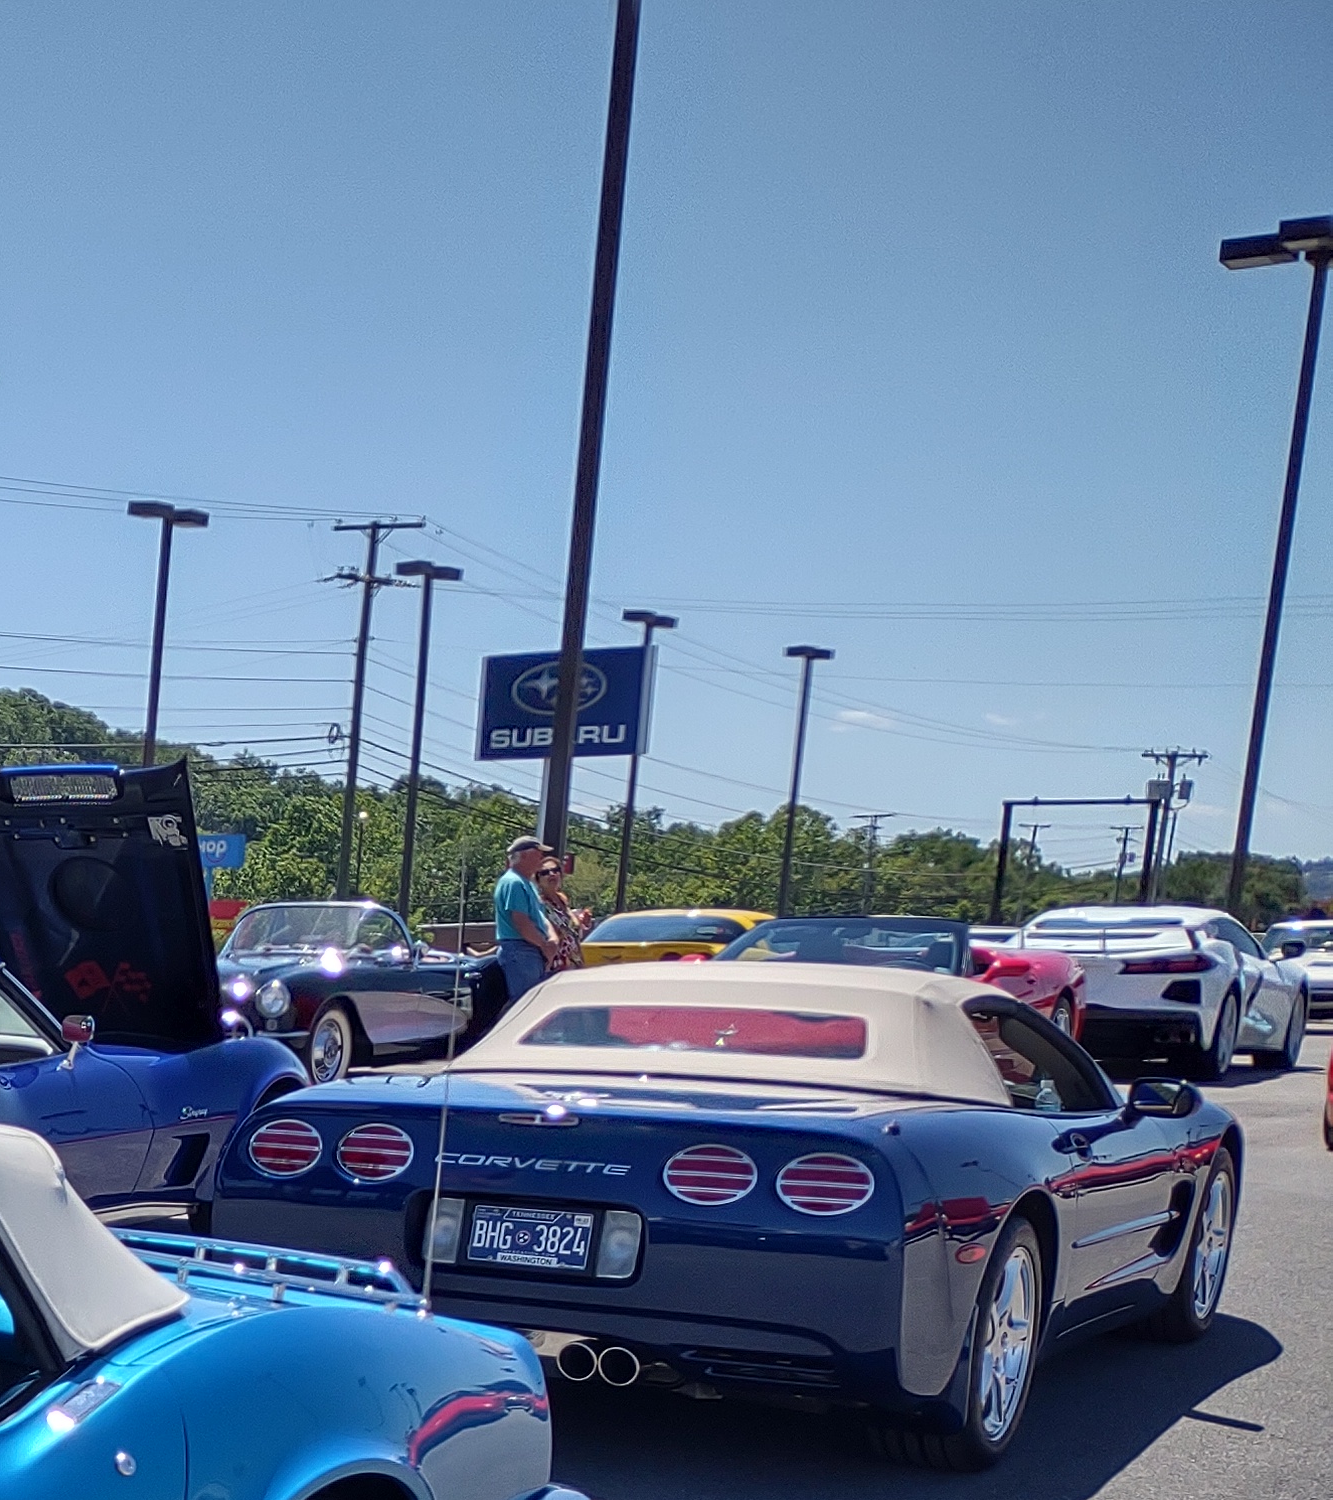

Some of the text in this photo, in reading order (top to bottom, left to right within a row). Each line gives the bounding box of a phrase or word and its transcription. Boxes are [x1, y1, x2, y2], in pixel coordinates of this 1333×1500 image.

[489, 724, 626, 750] SUBRU
[435, 1152, 632, 1177] CORVETTE
[512, 1210, 556, 1220] TENNESSEE
[472, 1219, 586, 1257] BHG 3824
[499, 1254, 552, 1266] WASHINGTON
